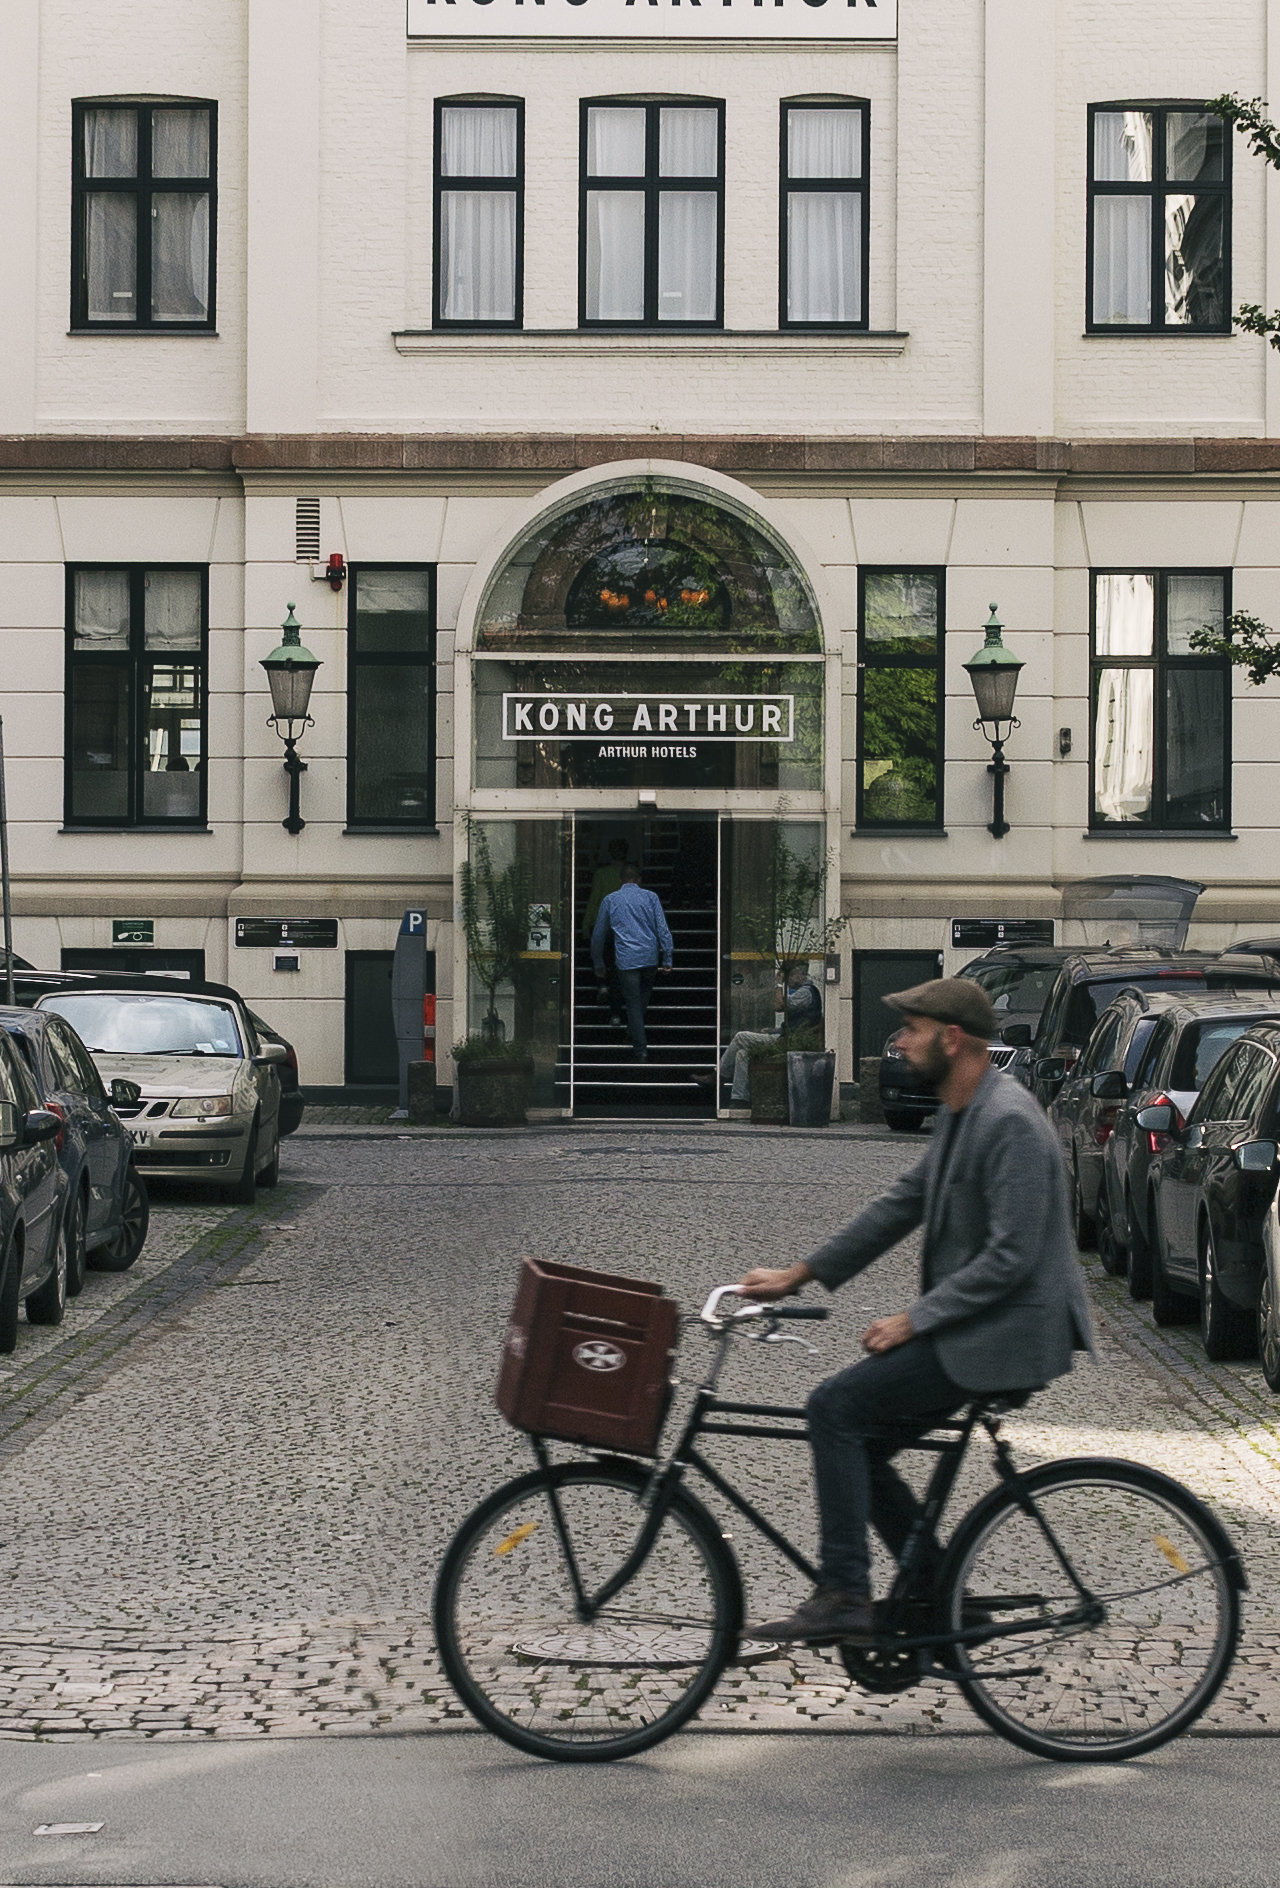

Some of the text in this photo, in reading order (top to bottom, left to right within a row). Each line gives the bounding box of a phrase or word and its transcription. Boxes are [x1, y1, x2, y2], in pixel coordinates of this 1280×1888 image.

[514, 702, 782, 733] KONG ARTHUR
[598, 746, 697, 759] ARTHUR HOTELS
[410, 912, 423, 932] P
